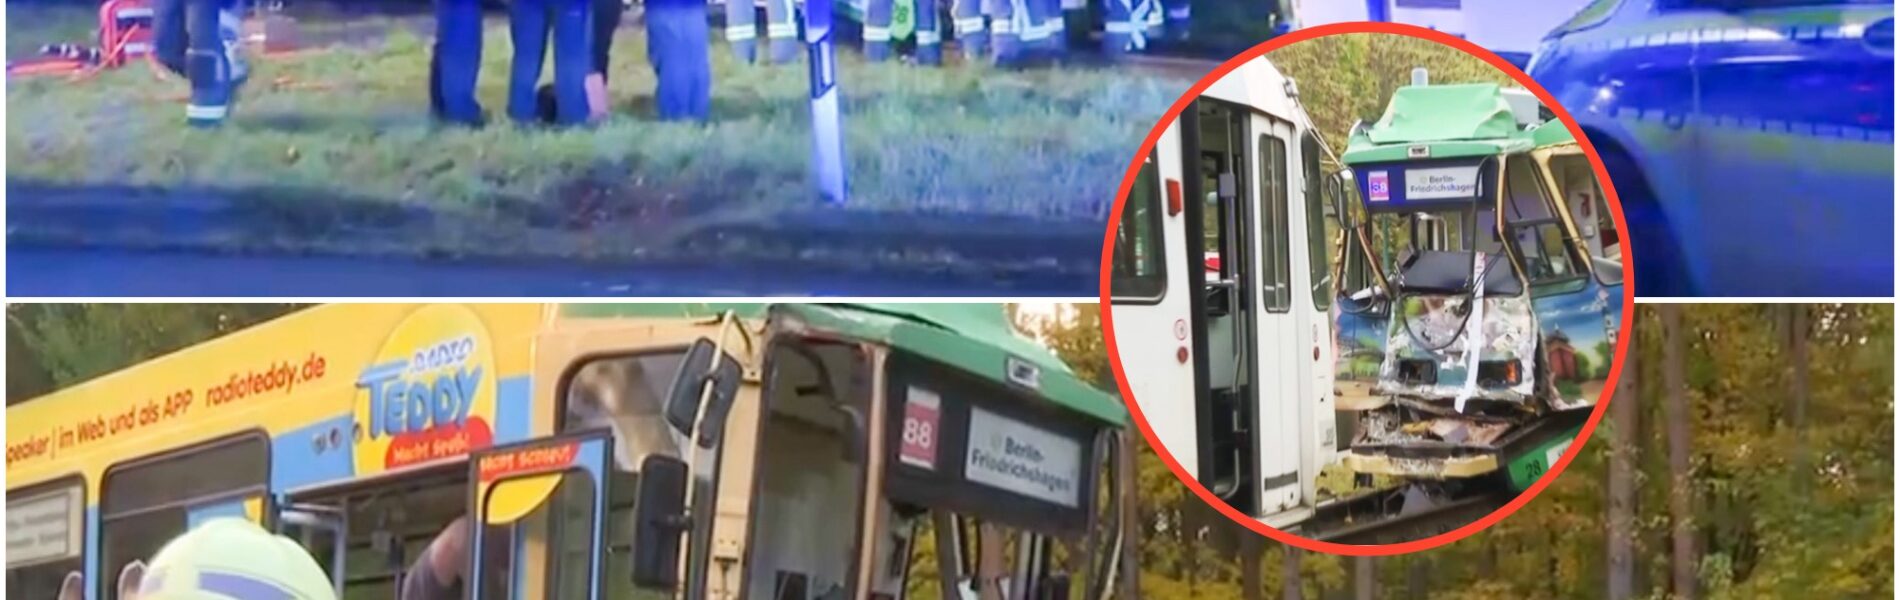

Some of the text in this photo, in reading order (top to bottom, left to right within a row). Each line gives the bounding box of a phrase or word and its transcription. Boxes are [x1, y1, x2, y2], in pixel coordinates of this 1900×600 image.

[1429, 175, 1456, 183] Berlin-
[59, 426, 74, 449] im
[77, 413, 106, 444] Web
[109, 404, 136, 435] und
[139, 400, 160, 426] als
[162, 389, 194, 419] APP
[206, 352, 326, 408] radioteddy.de
[355, 360, 483, 440] TEDDY
[903, 417, 932, 449] 88
[1005, 436, 1044, 462] Berlin-
[971, 448, 1071, 491] Friedrichshagen
[1525, 459, 1541, 479] 28
